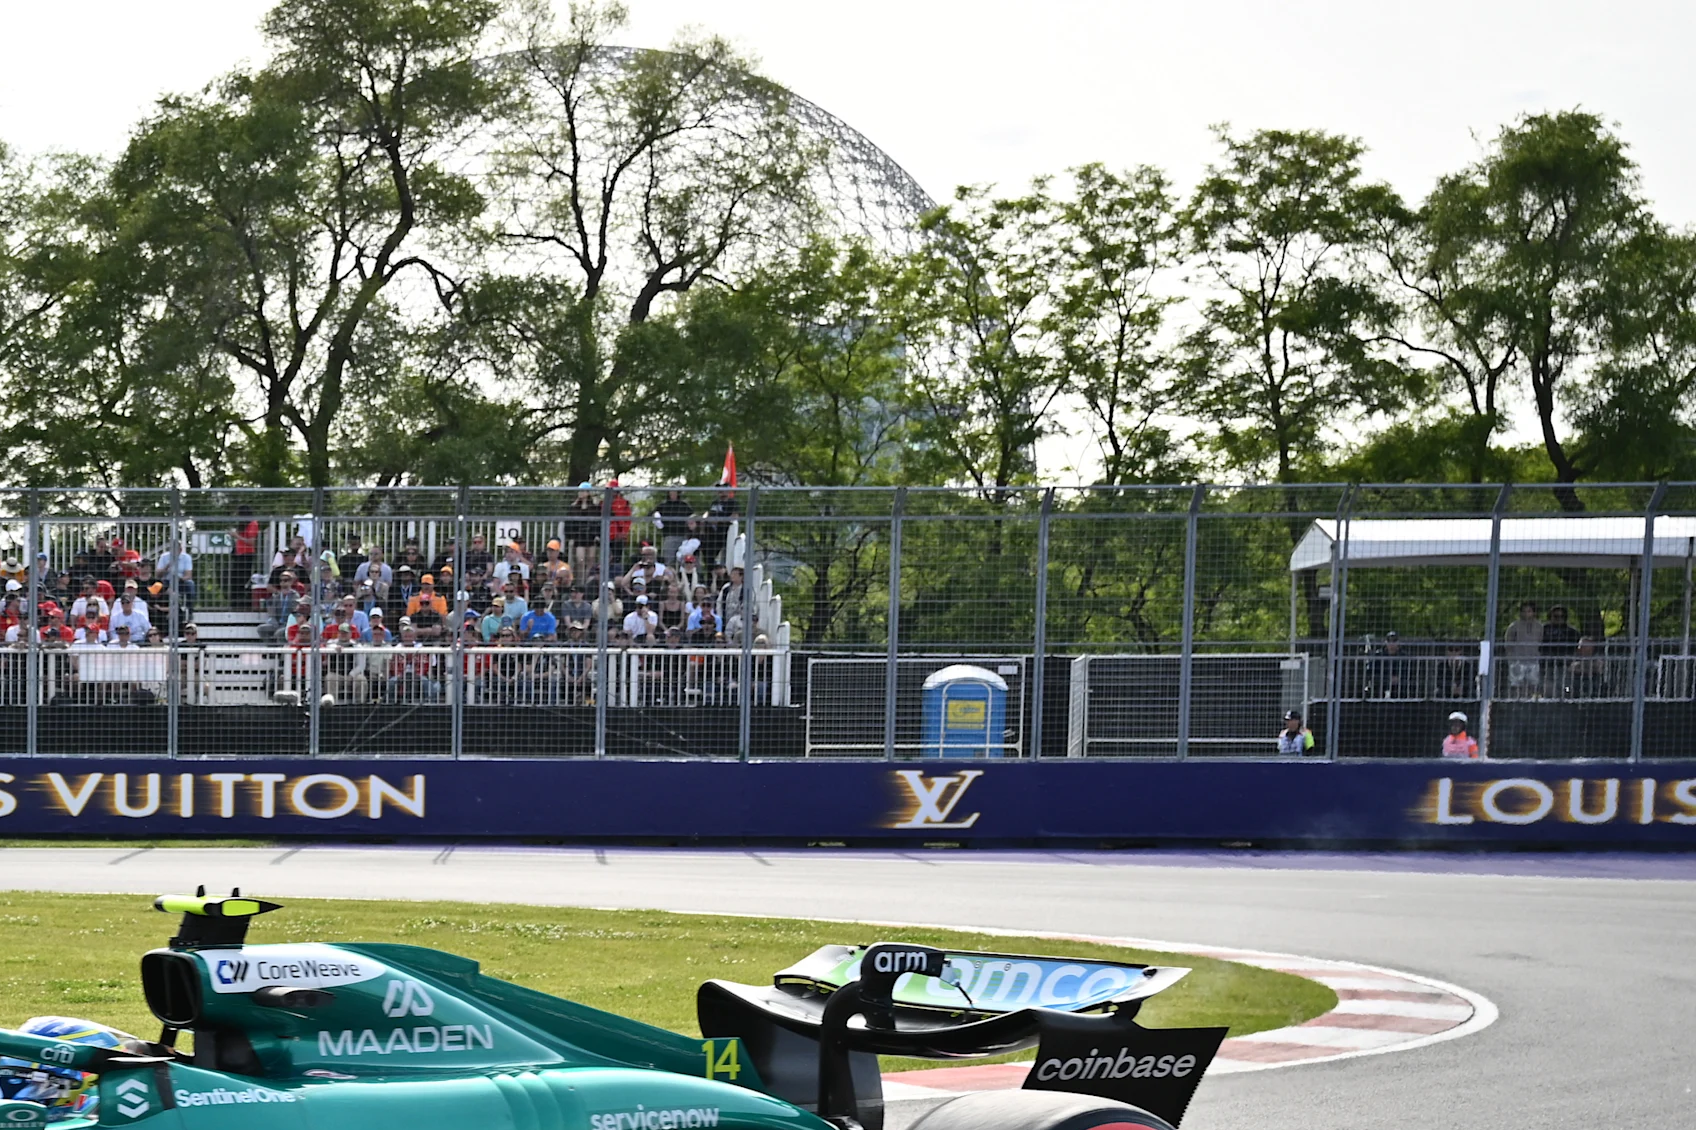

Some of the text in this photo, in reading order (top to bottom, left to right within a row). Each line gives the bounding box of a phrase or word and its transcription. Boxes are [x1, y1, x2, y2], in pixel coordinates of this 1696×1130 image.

[498, 528, 518, 540] 10
[47, 772, 426, 820] VUITTON
[1436, 777, 1696, 826] LOUIS
[257, 960, 362, 980] CoreWeave
[844, 952, 1126, 1004] amco
[874, 951, 928, 973] arm
[40, 1044, 75, 1064] citi
[318, 1023, 494, 1057] MAADEN
[702, 1040, 742, 1080] 14
[1037, 1047, 1197, 1082] coinbase
[174, 1086, 296, 1109] SentinelOne
